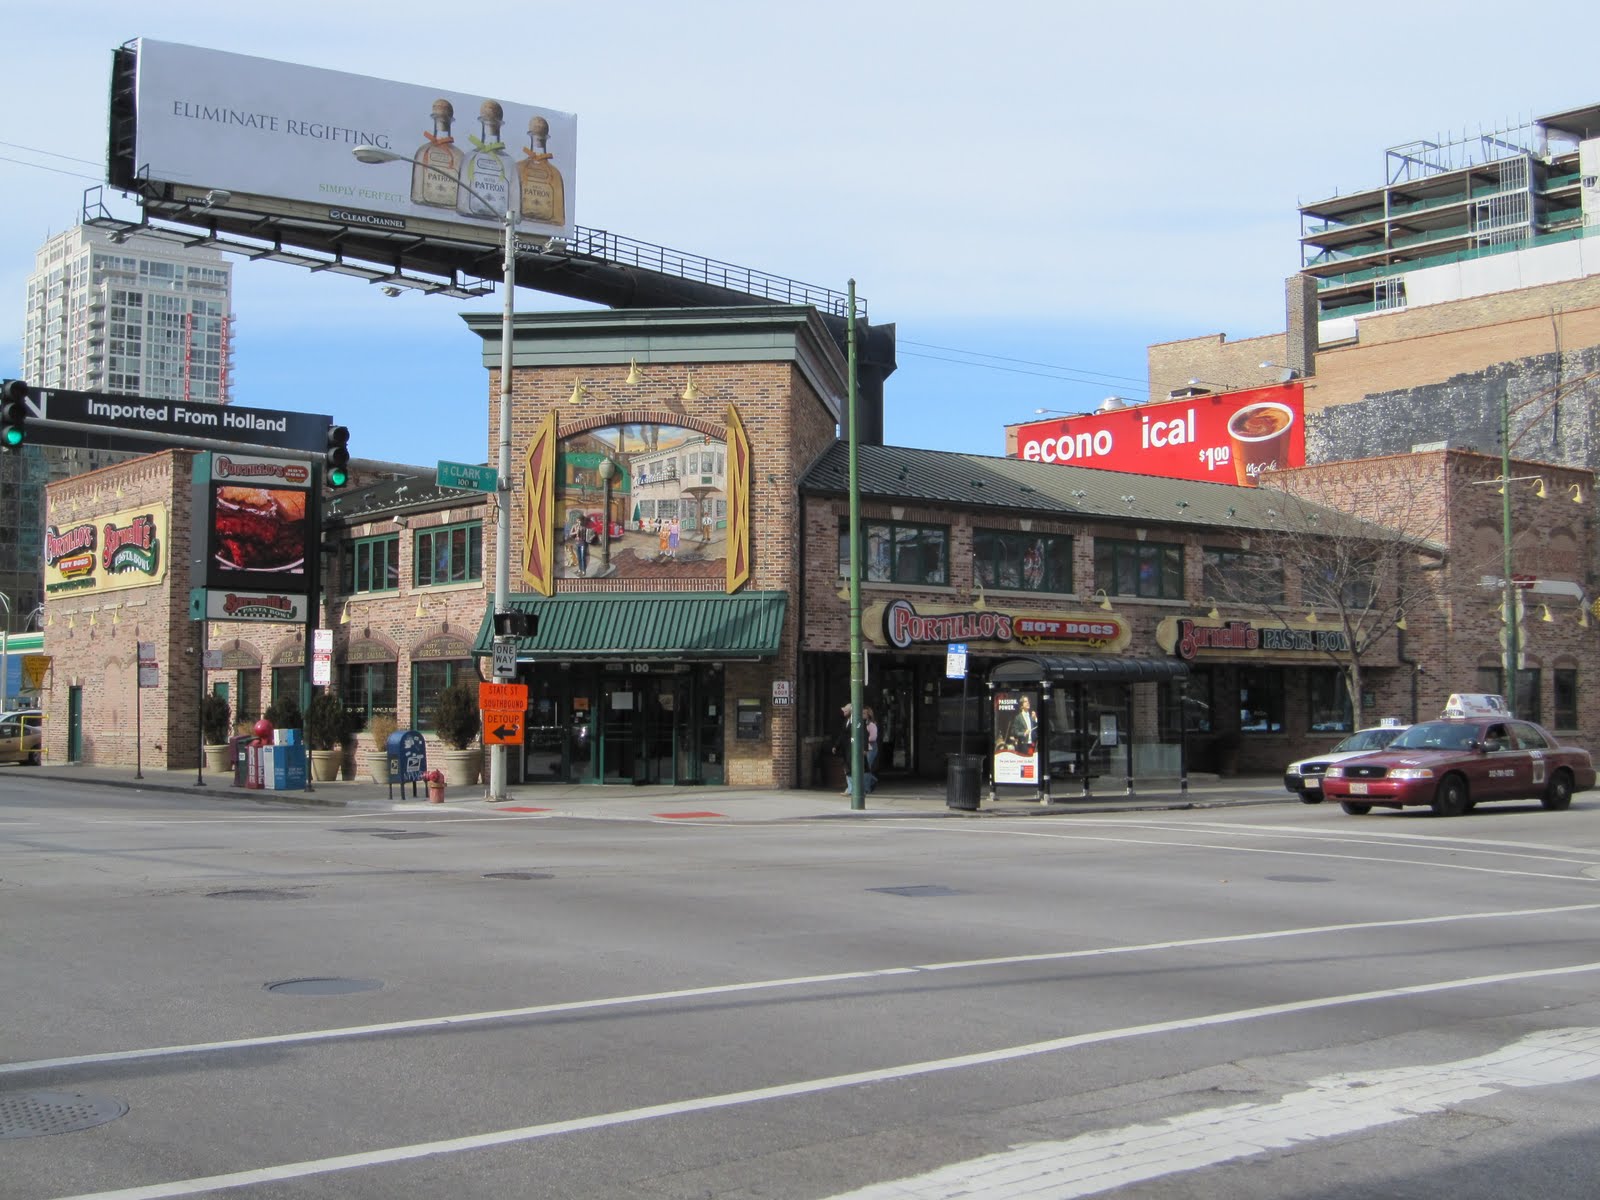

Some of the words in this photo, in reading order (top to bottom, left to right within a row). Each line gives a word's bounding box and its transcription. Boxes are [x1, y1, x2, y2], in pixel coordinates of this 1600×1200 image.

[173, 101, 279, 131] ELIMINATE
[287, 119, 392, 150] REGIFTING.
[318, 183, 355, 197] SIMPLY
[88, 399, 168, 421] Imported
[174, 407, 218, 426] From
[223, 412, 287, 432] Holland
[1023, 430, 1113, 462] econo
[1142, 409, 1195, 449] ical
[217, 457, 284, 478] PORTILLO'S
[450, 465, 481, 479] CLARK
[894, 606, 1013, 647] PORTILLO'S
[1021, 621, 1060, 632] HOT
[1066, 624, 1115, 635] DOGS
[1263, 629, 1313, 650] PASTA
[1316, 631, 1350, 651] BOW
[496, 646, 514, 654] ONE
[496, 655, 514, 664] WAY
[630, 663, 649, 673] 100
[489, 686, 508, 695] STATE
[511, 687, 518, 695] ST
[484, 700, 524, 709] SOUTHBOUND
[774, 697, 788, 705] ATM
